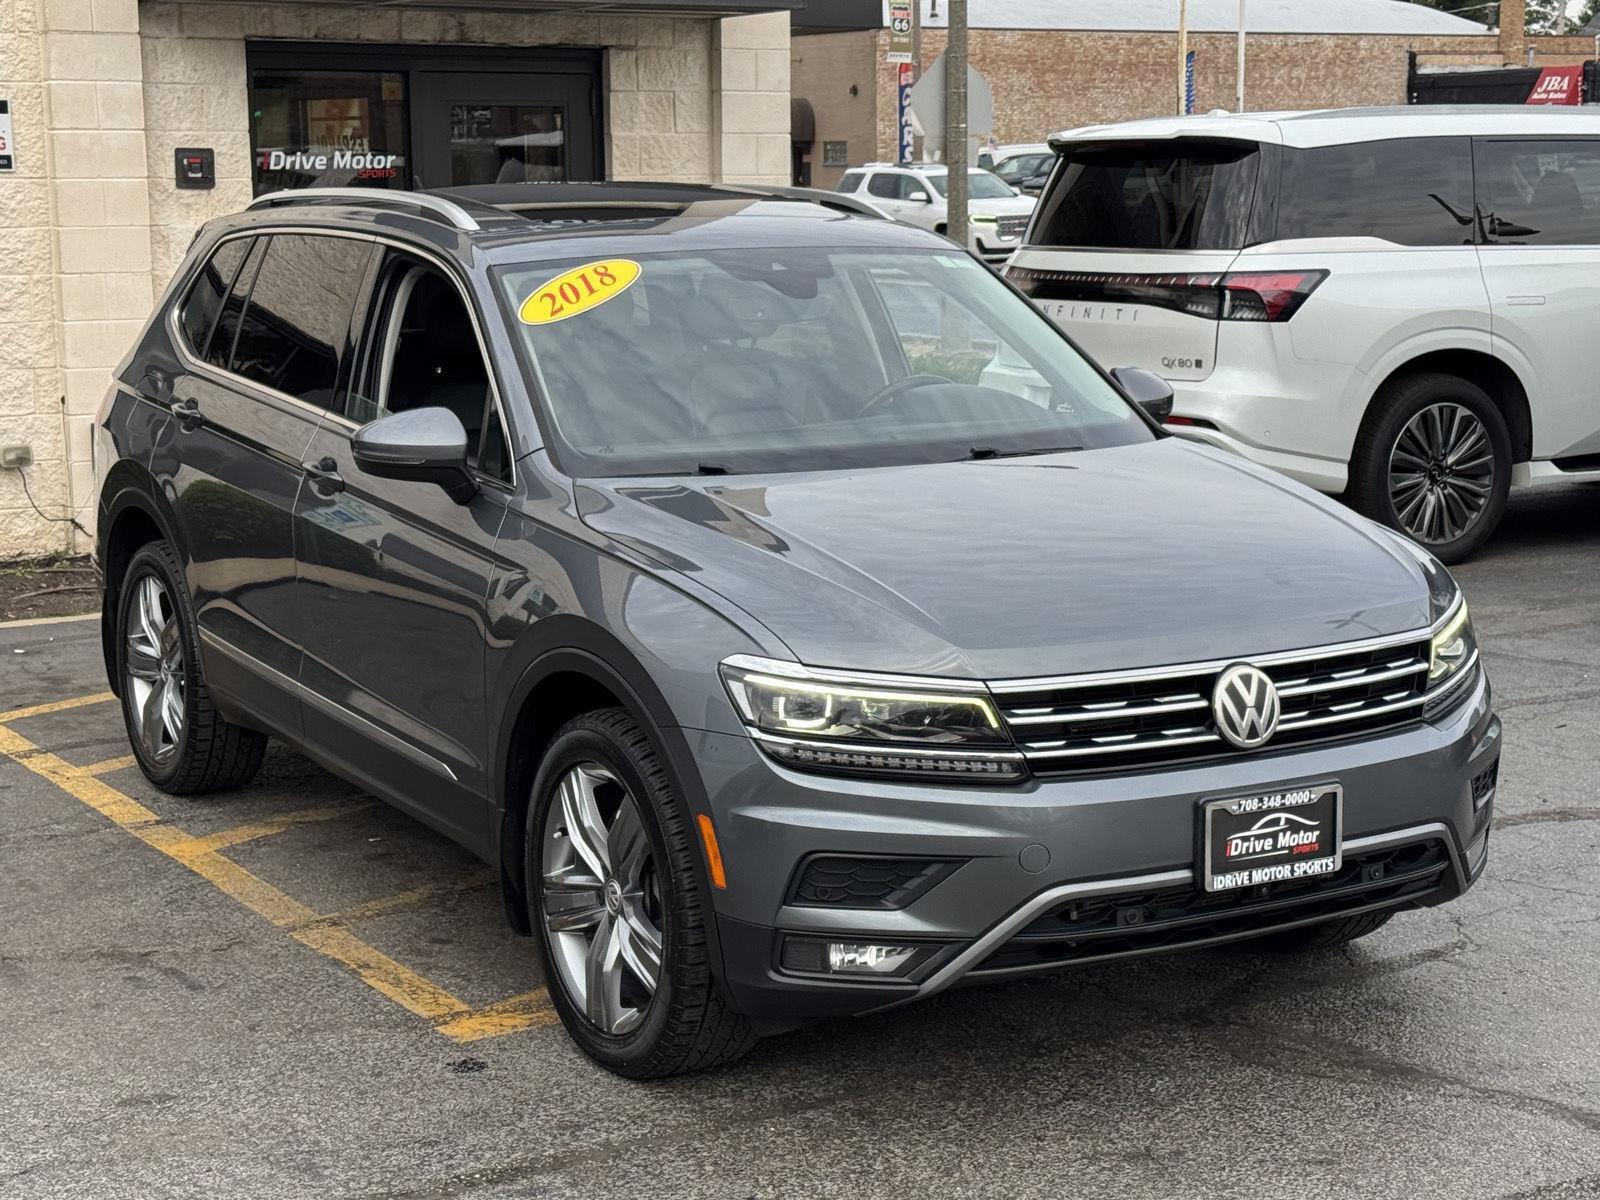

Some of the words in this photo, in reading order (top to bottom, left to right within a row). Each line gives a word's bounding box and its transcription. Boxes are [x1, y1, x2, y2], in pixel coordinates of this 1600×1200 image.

[894, 19, 909, 31] 66
[1537, 75, 1570, 93] JBA
[333, 151, 397, 170] Motor
[358, 168, 398, 179] SPORTS
[539, 265, 617, 317] 2018
[1042, 304, 1138, 322] NFINITI
[1161, 356, 1193, 369] QX80
[1240, 791, 1310, 812] 708-348-0000
[1225, 837, 1273, 858] iDrive
[1277, 829, 1320, 849] Motor
[1292, 843, 1320, 855] SPORTS
[1251, 864, 1292, 884] MOTOR
[1293, 857, 1335, 877] SPORTS
